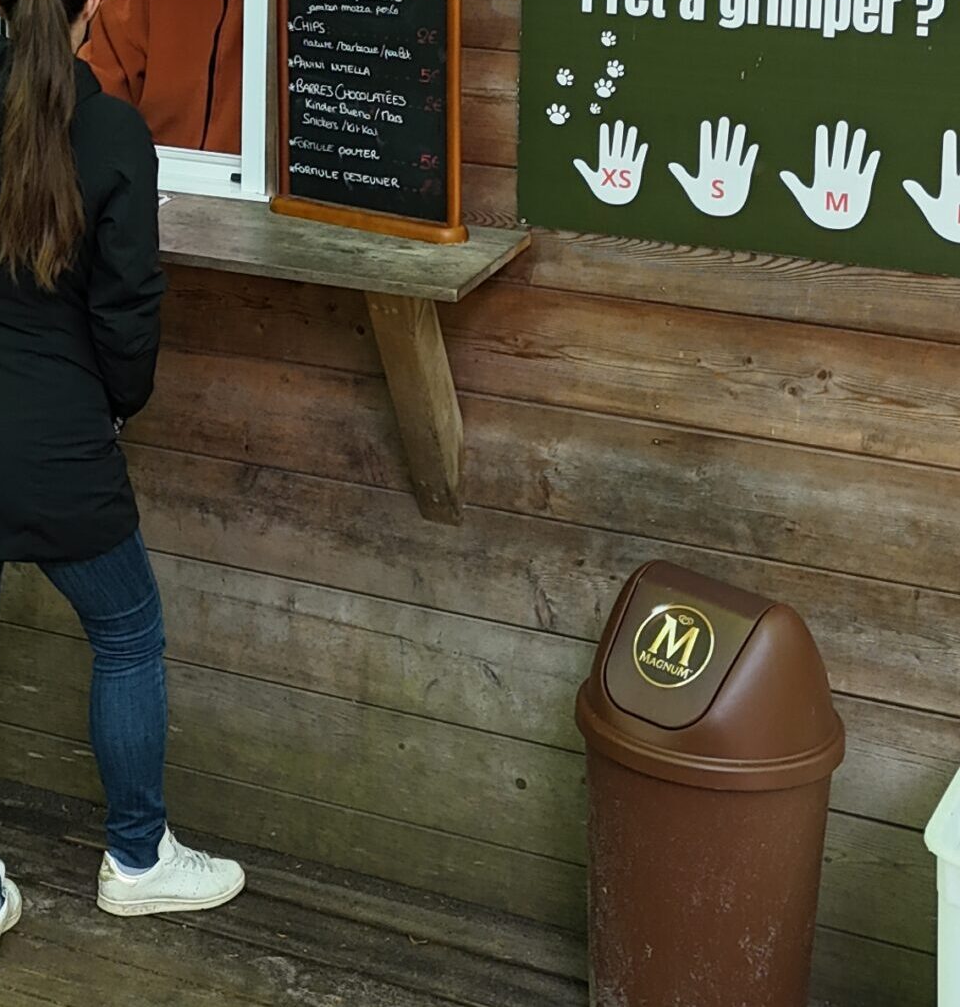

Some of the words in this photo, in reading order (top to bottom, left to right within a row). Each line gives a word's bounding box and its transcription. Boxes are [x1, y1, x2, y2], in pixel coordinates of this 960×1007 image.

[305, 98, 338, 113] Kinder
[600, 168, 632, 190] XS
[711, 179, 725, 199] S
[825, 191, 849, 212] M
[639, 650, 689, 680] MAGNUM
